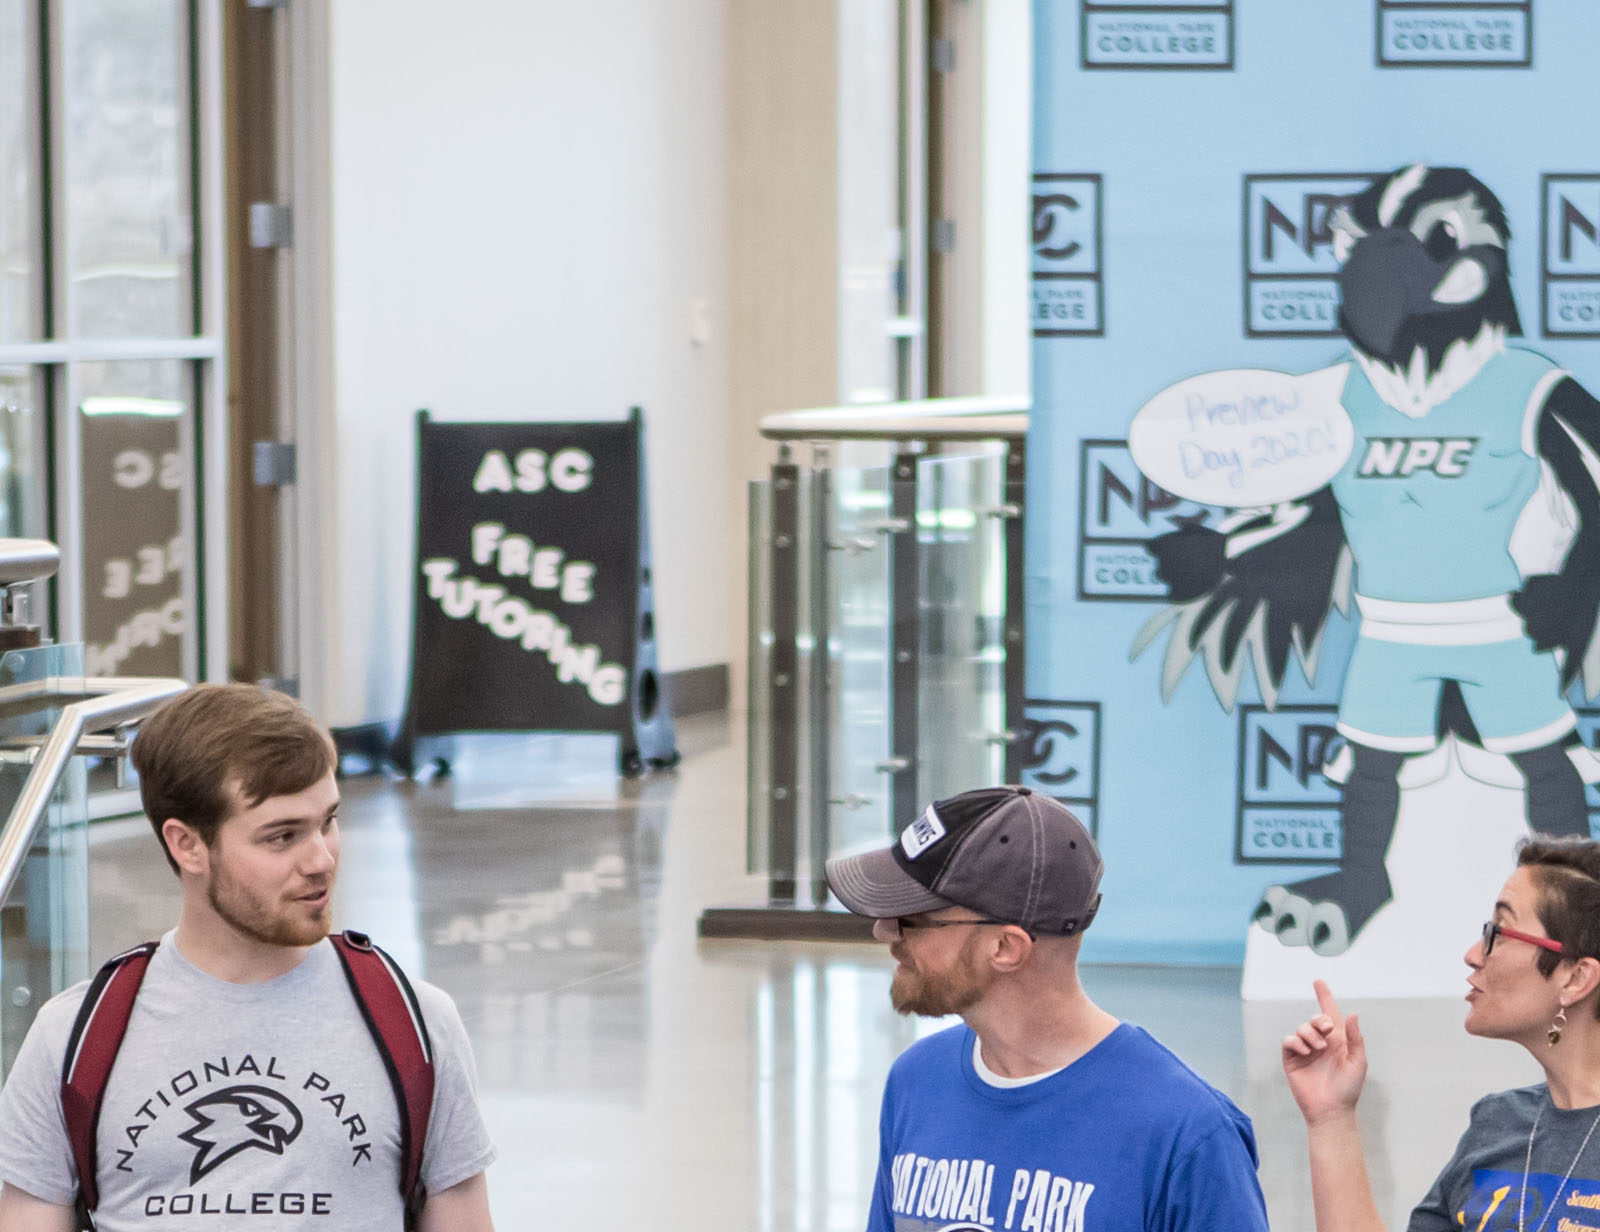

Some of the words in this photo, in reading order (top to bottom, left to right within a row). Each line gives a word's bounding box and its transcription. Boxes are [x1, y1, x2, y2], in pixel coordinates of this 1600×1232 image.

[1099, 36, 1215, 53] COLLEGE
[1393, 33, 1513, 51] COLLEGE
[1262, 304, 1338, 320] COLL
[1186, 390, 1299, 432] Preview
[473, 448, 593, 493] ASC
[1179, 440, 1244, 489] Day
[1355, 437, 1479, 478] NPC
[471, 521, 596, 604] FREE
[422, 557, 626, 706] TUTORING
[116, 1054, 286, 1172] NATIONAL
[302, 1071, 372, 1167] PARK
[145, 1192, 333, 1216] COLLEGE
[892, 1152, 995, 1226] NATIONAL
